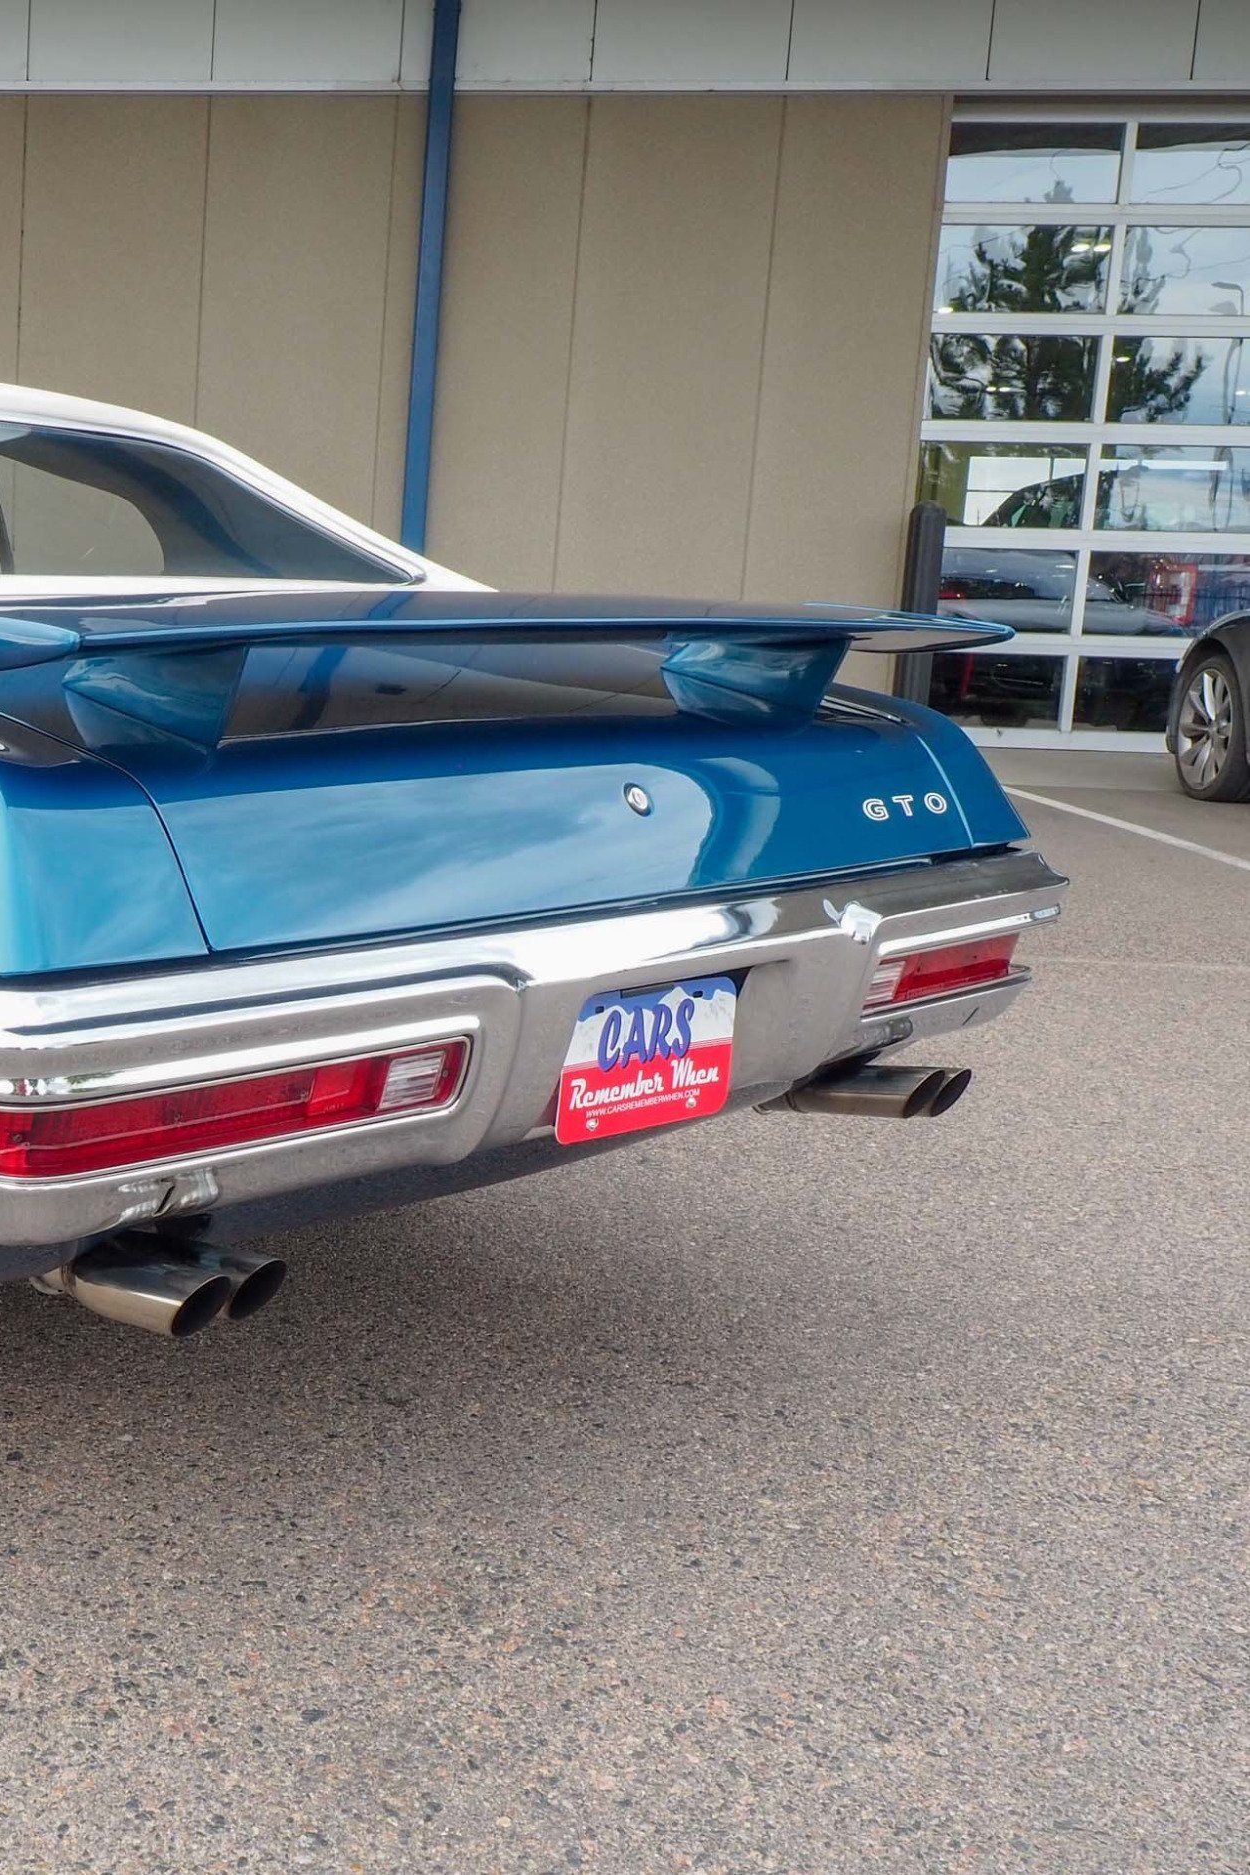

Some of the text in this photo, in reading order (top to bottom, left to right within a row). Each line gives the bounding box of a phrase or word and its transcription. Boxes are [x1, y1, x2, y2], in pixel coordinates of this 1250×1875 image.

[862, 792, 947, 821] GTO
[598, 998, 695, 1072] CARS
[569, 1058, 719, 1110] Remember When
[586, 1089, 700, 1118] WWW.CARSREMEMBERWHEN.COM
